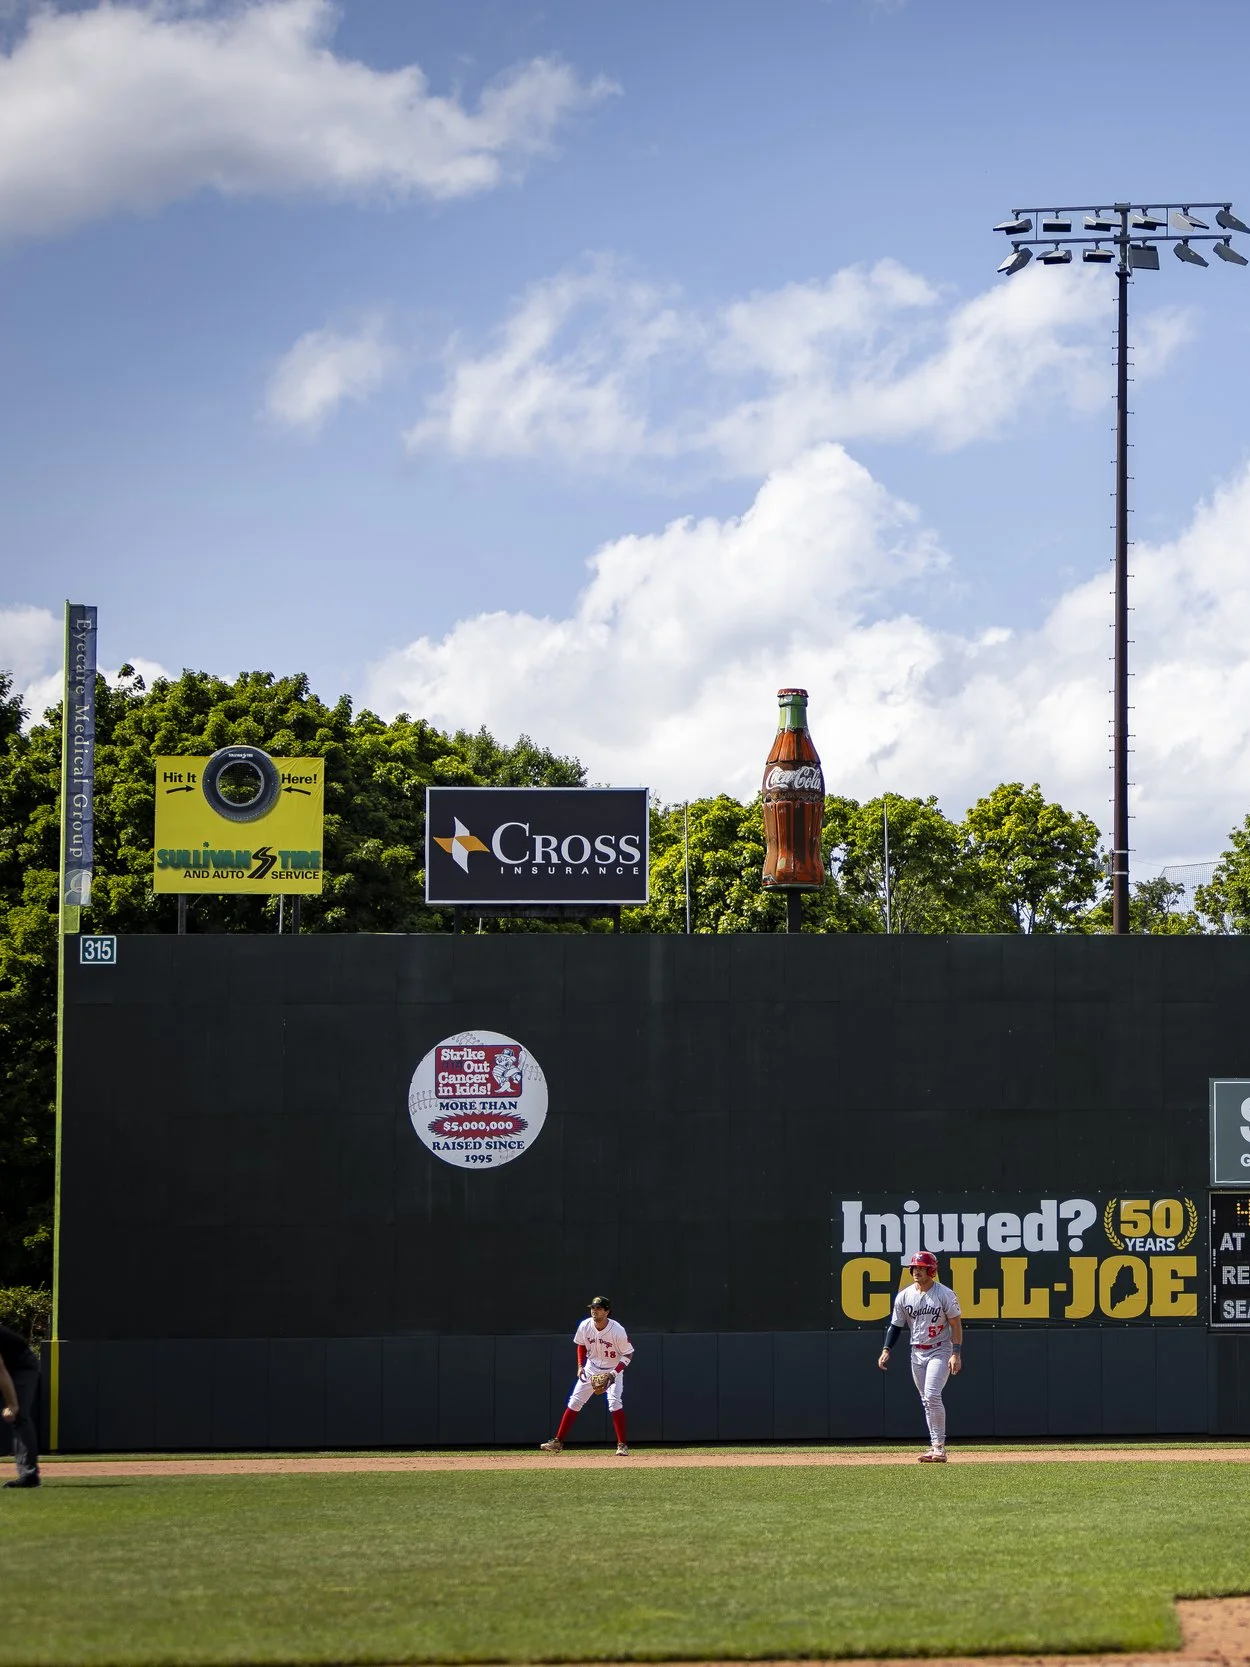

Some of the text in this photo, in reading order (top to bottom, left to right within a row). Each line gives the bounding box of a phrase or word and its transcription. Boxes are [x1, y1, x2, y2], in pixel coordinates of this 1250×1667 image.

[70, 618, 92, 858] Eyecare Medical Group
[163, 772, 196, 784] Hit It
[281, 773, 317, 784] Here!
[492, 822, 641, 864] CROSS
[278, 850, 321, 870] TIRE
[271, 871, 319, 879] SERVICE
[85, 941, 111, 960] 315
[441, 1049, 485, 1060] Strike
[463, 1061, 490, 1072] Out
[438, 1072, 489, 1083] Cancer
[438, 1083, 491, 1095] in kids!
[439, 1101, 518, 1110] MORE THAN
[443, 1121, 513, 1131] $5,000,000
[432, 1141, 525, 1150] RAISED SINCE
[465, 1155, 493, 1163] 1995
[1120, 1199, 1184, 1237] 50
[842, 1199, 1097, 1266] Injured?
[1125, 1238, 1176, 1251] YEARS
[1220, 1232, 1245, 1250] AT
[905, 1304, 941, 1323] Reading
[928, 1325, 944, 1338] 57
